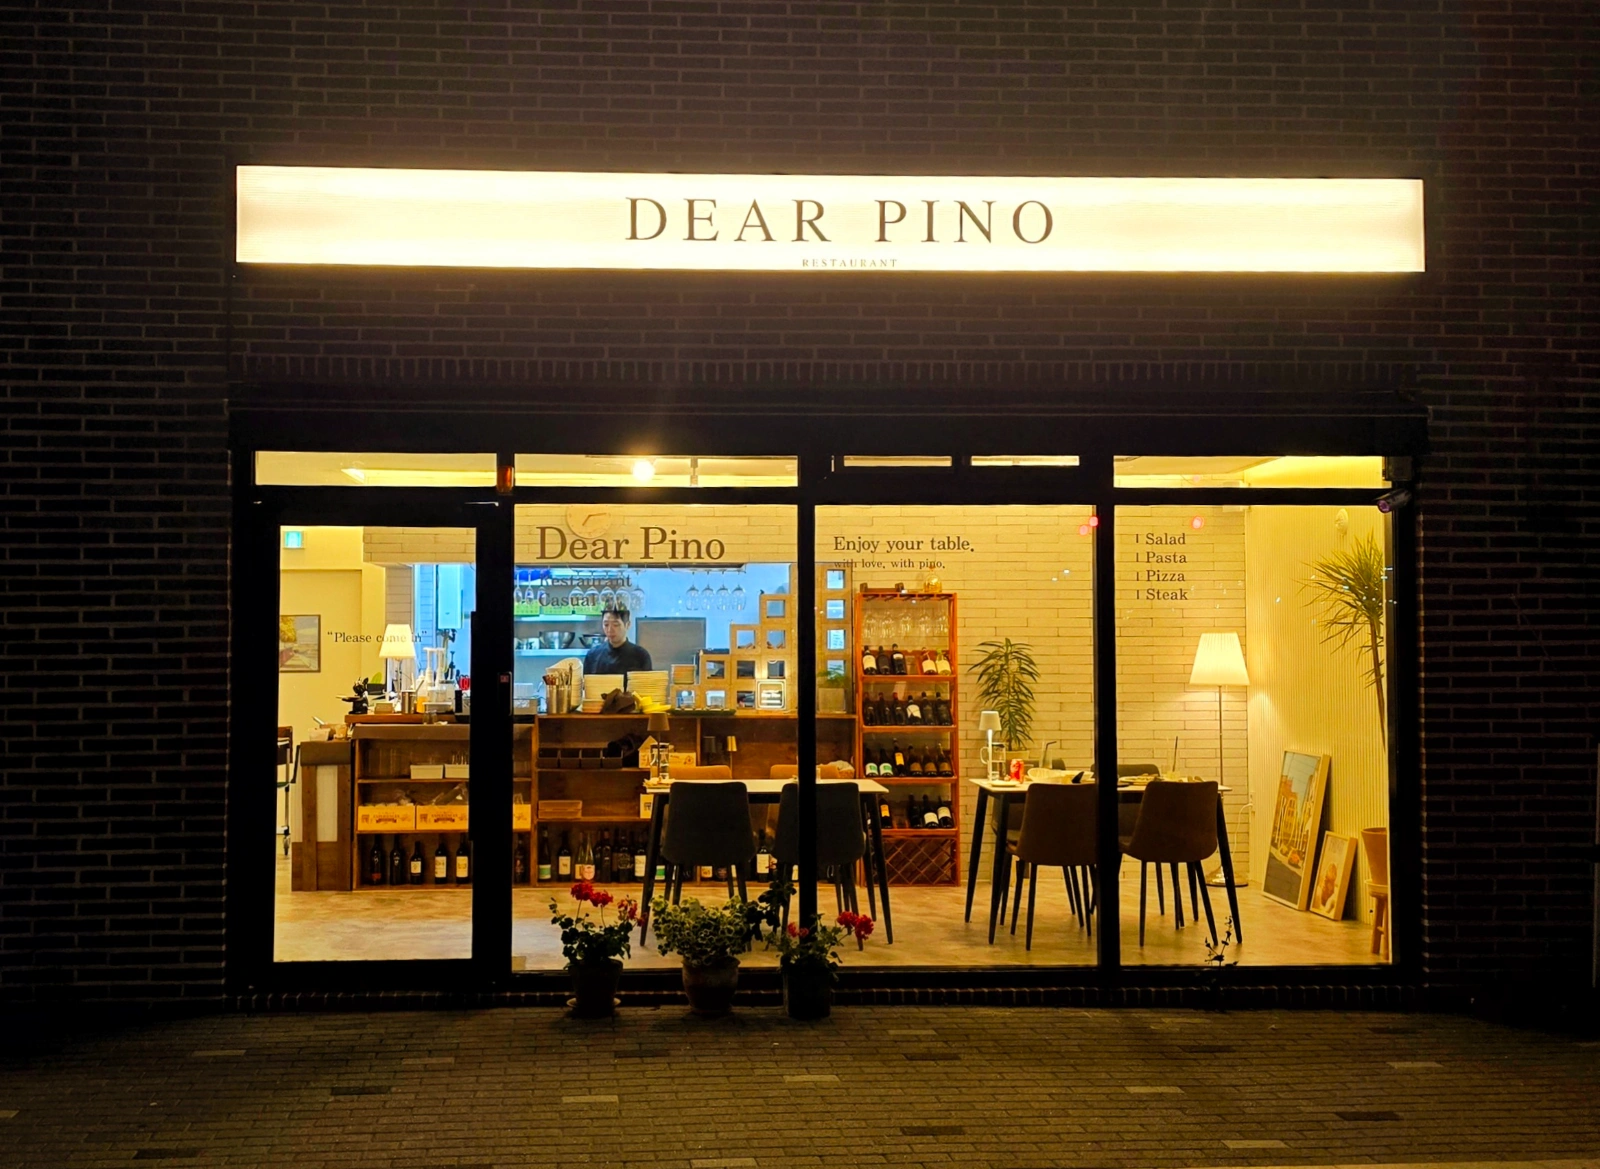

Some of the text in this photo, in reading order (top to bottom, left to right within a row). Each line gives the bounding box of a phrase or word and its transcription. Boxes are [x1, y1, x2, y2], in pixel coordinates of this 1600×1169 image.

[625, 197, 1054, 244] DEAR PINO
[802, 258, 898, 268] RESTAURANT
[535, 526, 725, 560] Dear Pino
[833, 536, 975, 553] Enjoy your table.
[1145, 533, 1186, 545] Salad
[1146, 551, 1187, 563] Pasta
[834, 559, 857, 568] with
[891, 559, 914, 568] with
[540, 573, 632, 587] Restaurant
[1146, 570, 1185, 582] Pizza
[538, 591, 597, 607] Casual
[1146, 588, 1188, 600] Steak
